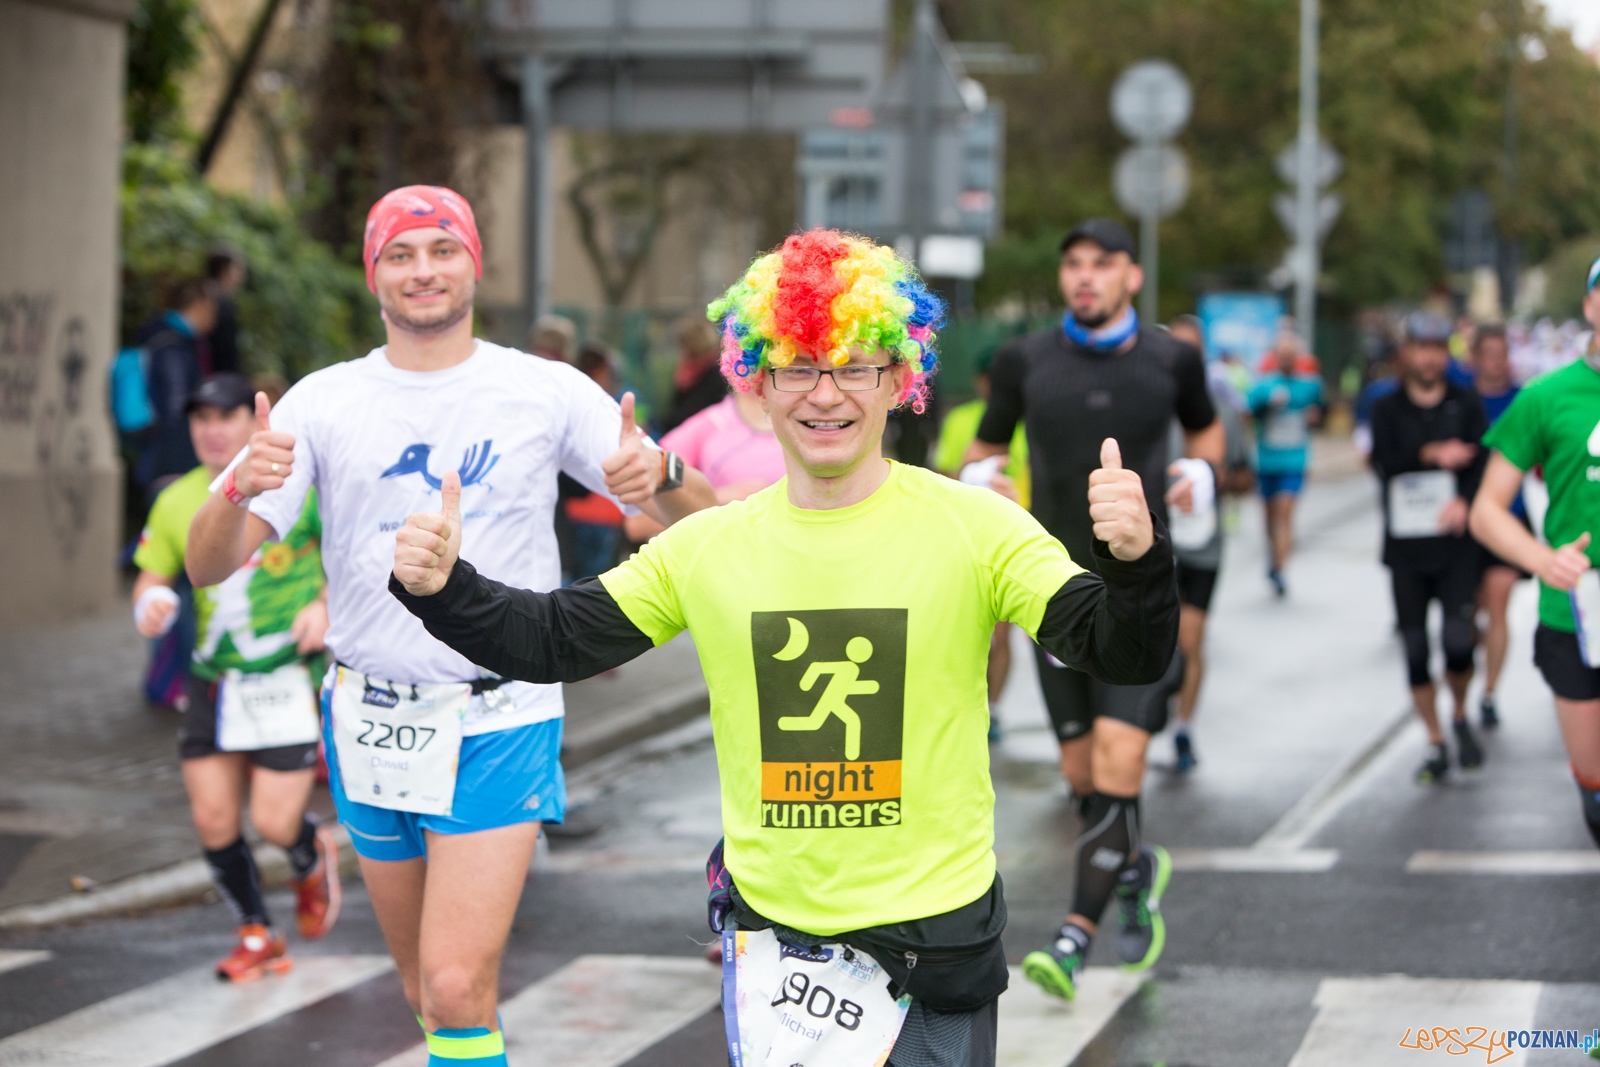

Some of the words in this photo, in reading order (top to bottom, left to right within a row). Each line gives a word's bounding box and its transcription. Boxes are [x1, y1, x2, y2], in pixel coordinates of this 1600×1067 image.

[357, 719, 436, 752] 2207
[371, 756, 409, 771] Dawid
[785, 763, 874, 800] night
[762, 801, 900, 827] runners
